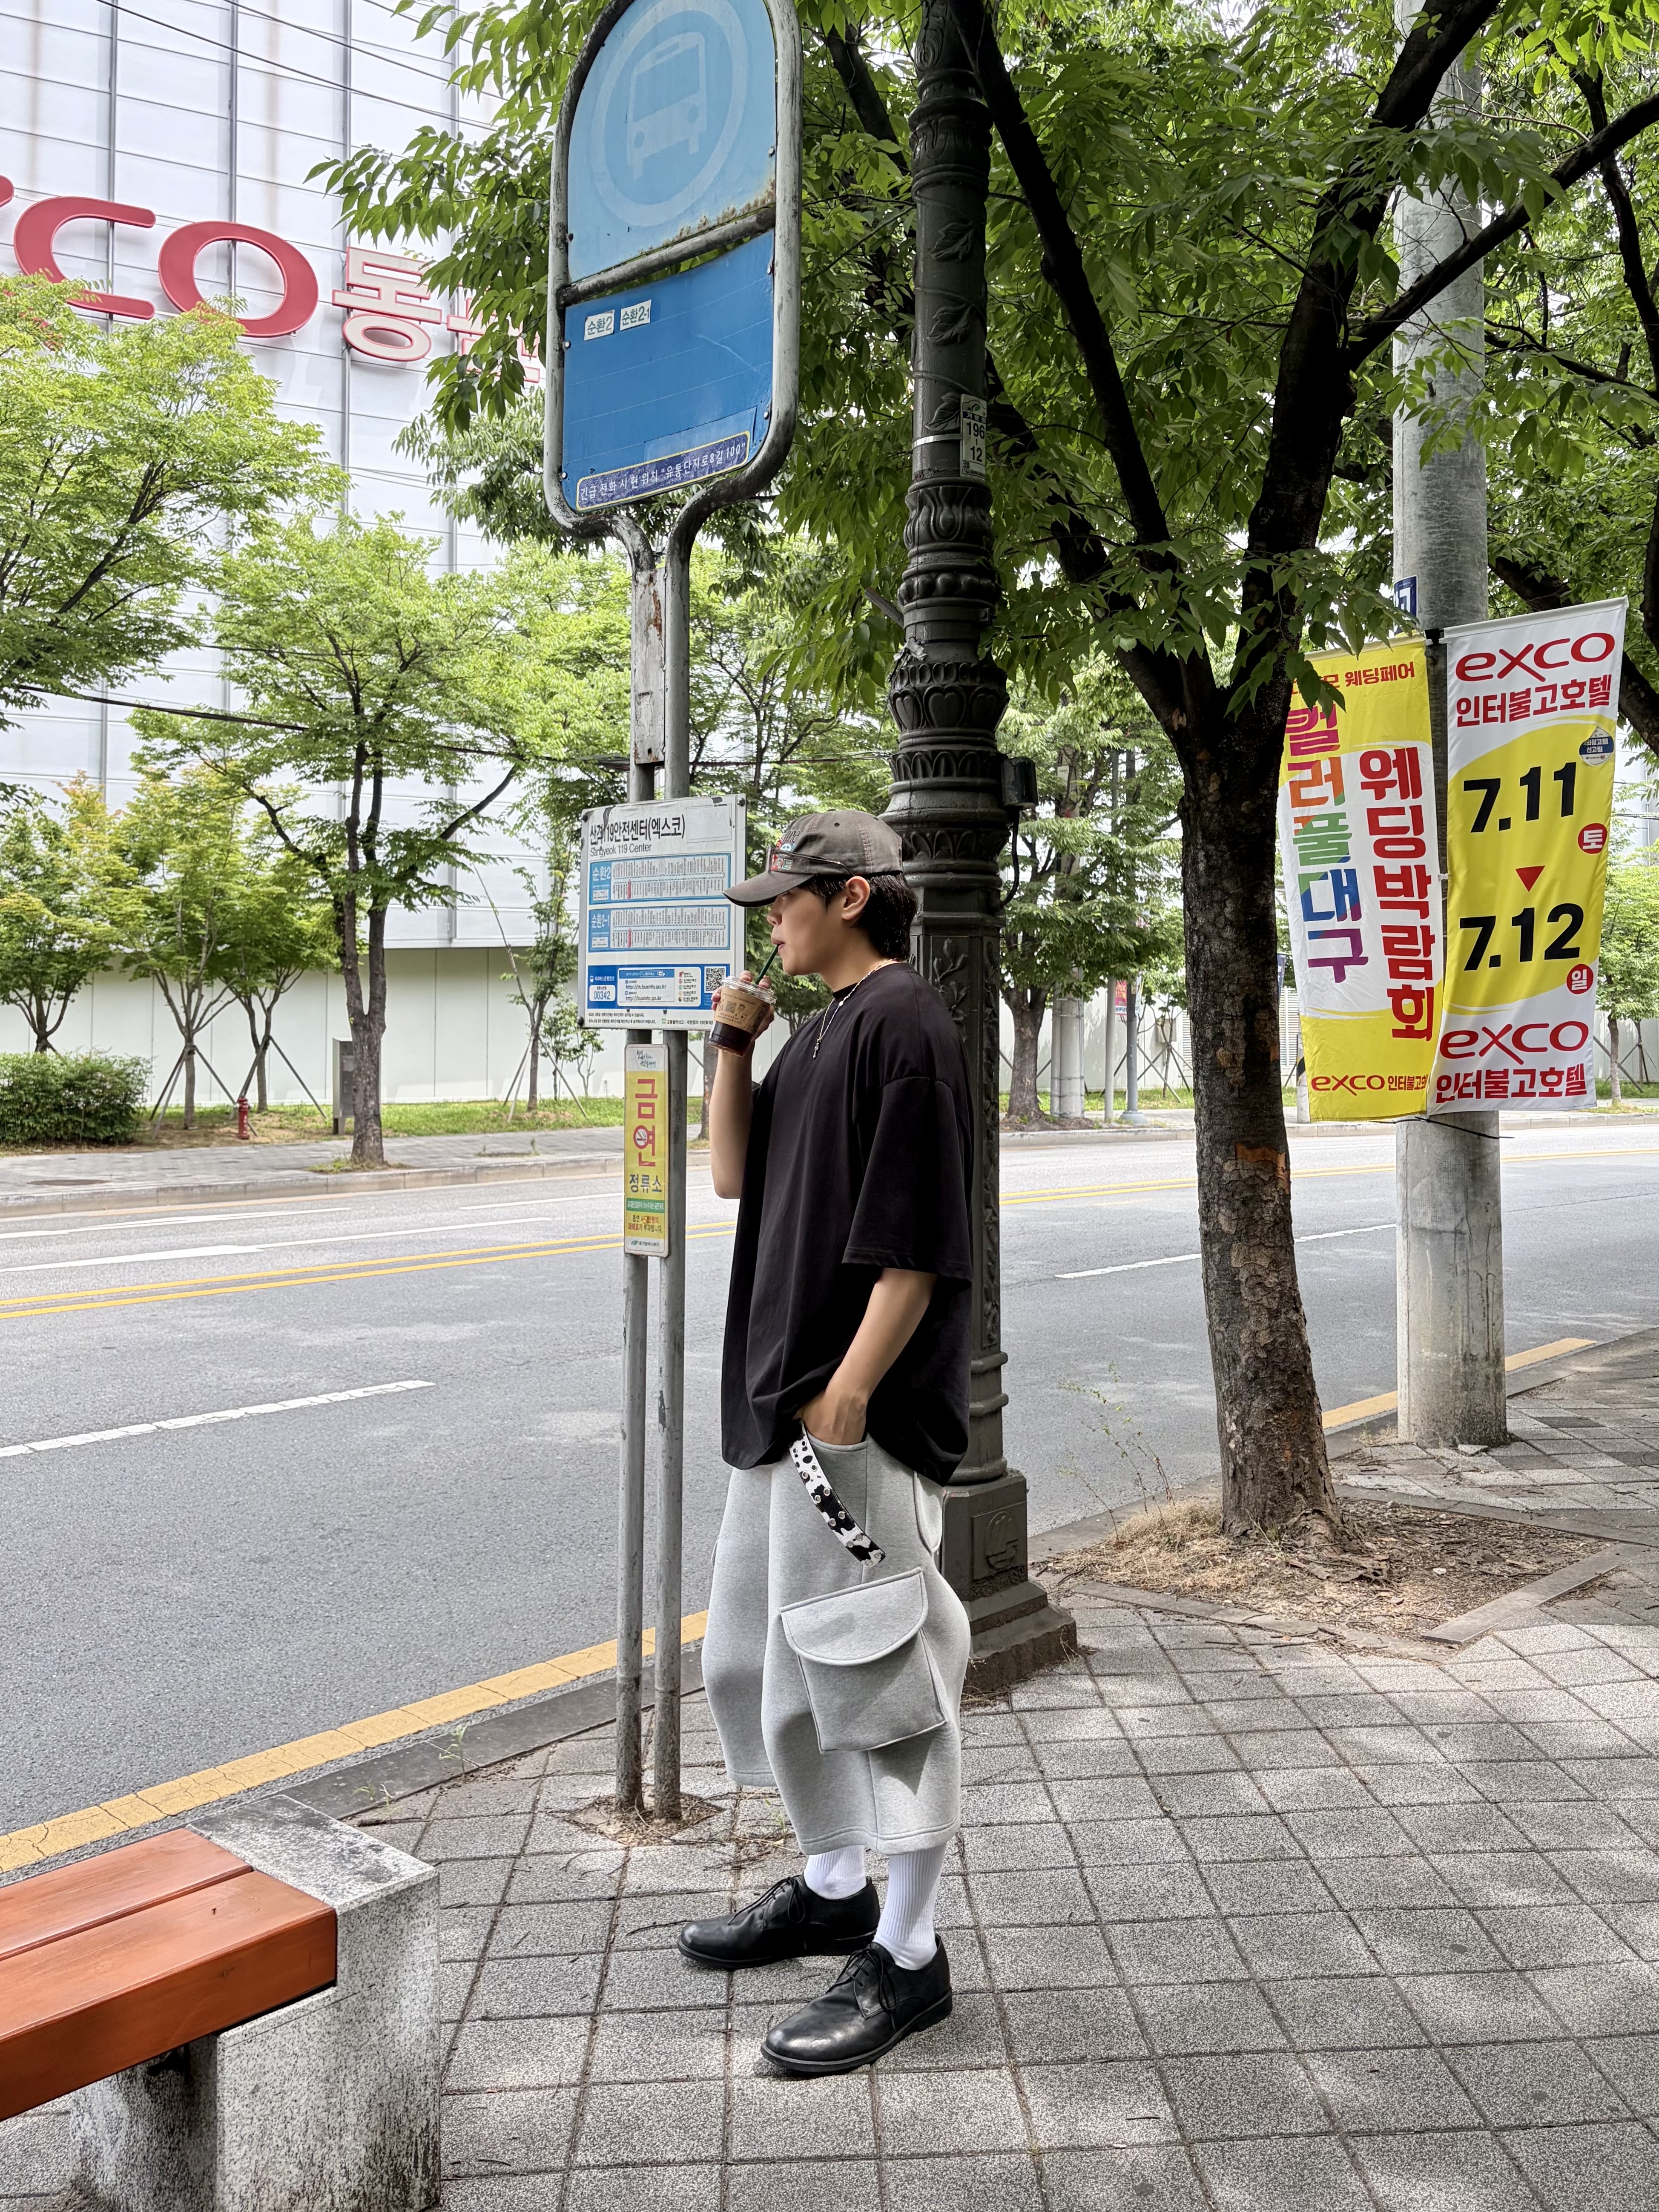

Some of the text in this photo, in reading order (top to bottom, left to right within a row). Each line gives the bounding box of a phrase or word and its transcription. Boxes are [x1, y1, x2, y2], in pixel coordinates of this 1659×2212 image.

[587, 316, 612, 335] 순환2
[622, 305, 650, 326] 순환2-1
[966, 422, 985, 439] 196
[970, 446, 982, 462] 12
[580, 486, 595, 501] 긴급
[600, 480, 617, 495] 전화
[620, 477, 628, 491] 시
[630, 474, 638, 490] 현
[641, 469, 658, 485] 위치
[1455, 632, 1615, 682] exco
[1344, 661, 1415, 687] 웨딩페어
[1456, 674, 1612, 728] 인터불고호텔
[1463, 762, 1577, 833] 7.11
[590, 843, 652, 858] Sangyeok 119 Center
[1582, 830, 1604, 850] 토
[592, 866, 611, 882] 순환2
[1359, 747, 1435, 1041] 웨딩박람회
[592, 913, 610, 928] 순환2-1
[1460, 903, 1584, 971] 7.12
[1571, 969, 1588, 990] 일
[594, 991, 611, 1000] 00342
[1439, 1021, 1589, 1065] exco
[1311, 1074, 1385, 1096] exco
[1436, 1063, 1587, 1104] 인터불고호텔
[629, 1173, 662, 1193] 정류소
